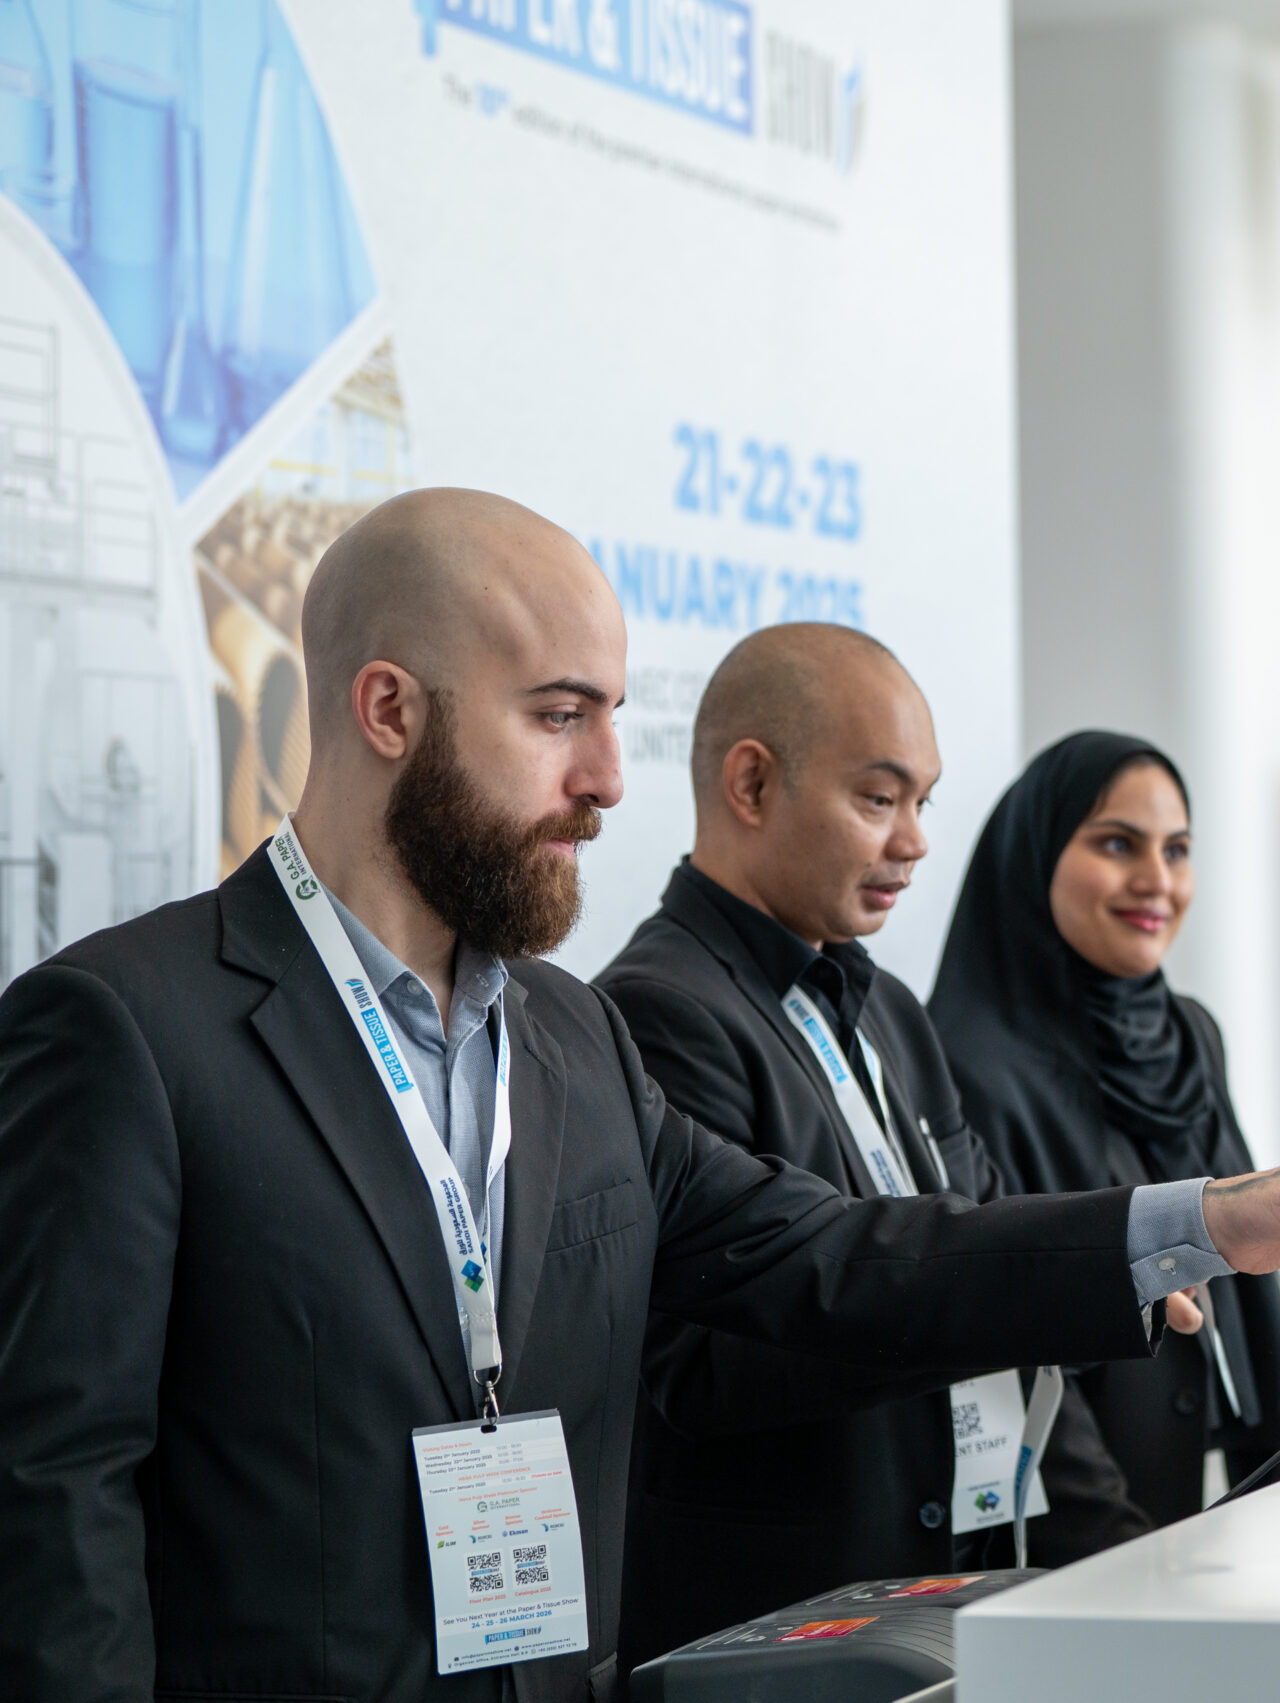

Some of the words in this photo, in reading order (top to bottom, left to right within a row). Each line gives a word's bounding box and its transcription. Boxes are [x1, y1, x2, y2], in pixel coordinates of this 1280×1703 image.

[274, 836, 292, 862] PAPE
[351, 985, 373, 1009] SHOW
[363, 1010, 386, 1044] TISSUE
[384, 1055, 407, 1086] PAPER
[448, 1177, 460, 1203] GROUP
[457, 1204, 468, 1229] PAPER
[464, 1230, 474, 1254] SAUDI
[975, 1436, 1008, 1454] STAFF
[471, 1621, 480, 1629] 24
[509, 1613, 535, 1622] MARCH
[535, 1610, 552, 1618] 2026
[518, 1605, 535, 1613] Paper
